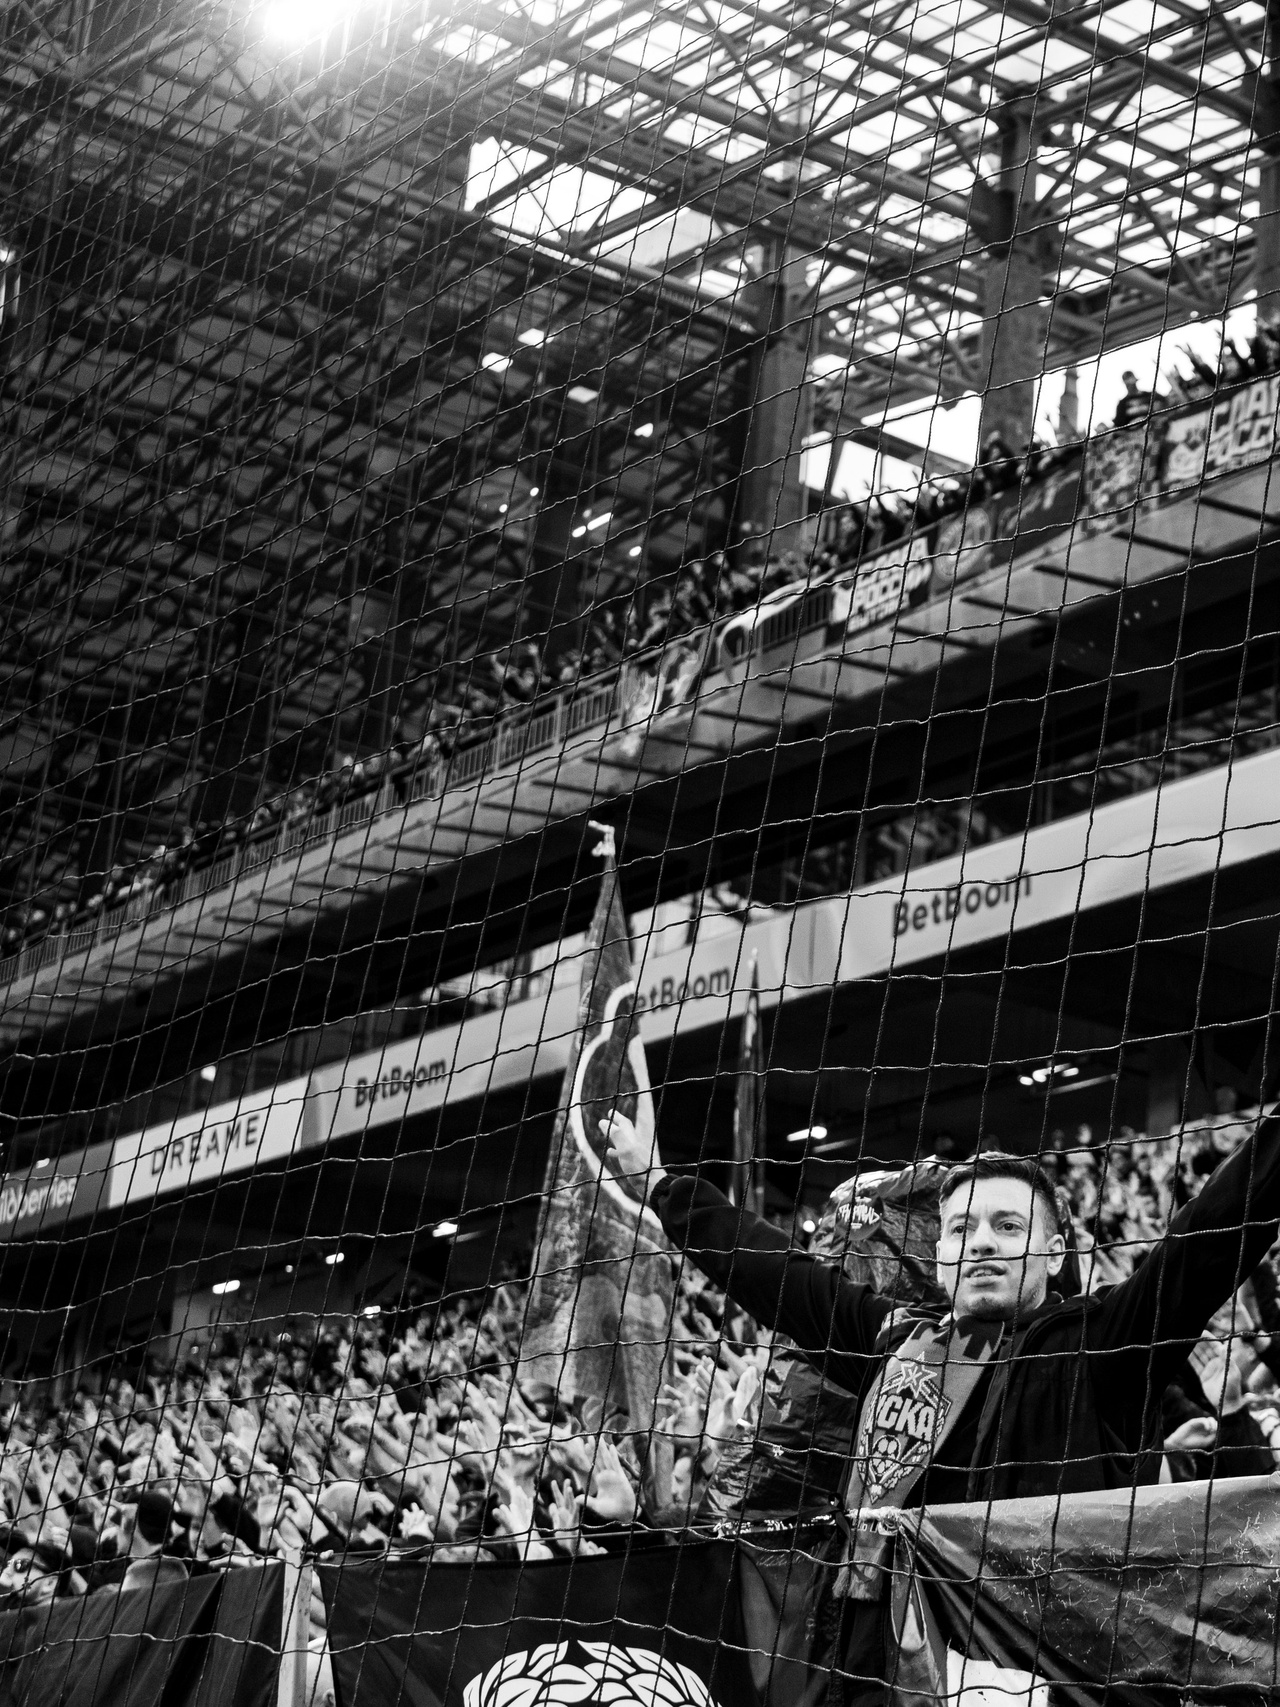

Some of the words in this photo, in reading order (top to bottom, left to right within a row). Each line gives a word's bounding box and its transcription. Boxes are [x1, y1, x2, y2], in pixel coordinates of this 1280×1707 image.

[892, 871, 1032, 938] BetBoom
[630, 967, 730, 1017] etBoom
[355, 1059, 447, 1109] BetBoom
[150, 1114, 261, 1177] DREAME
